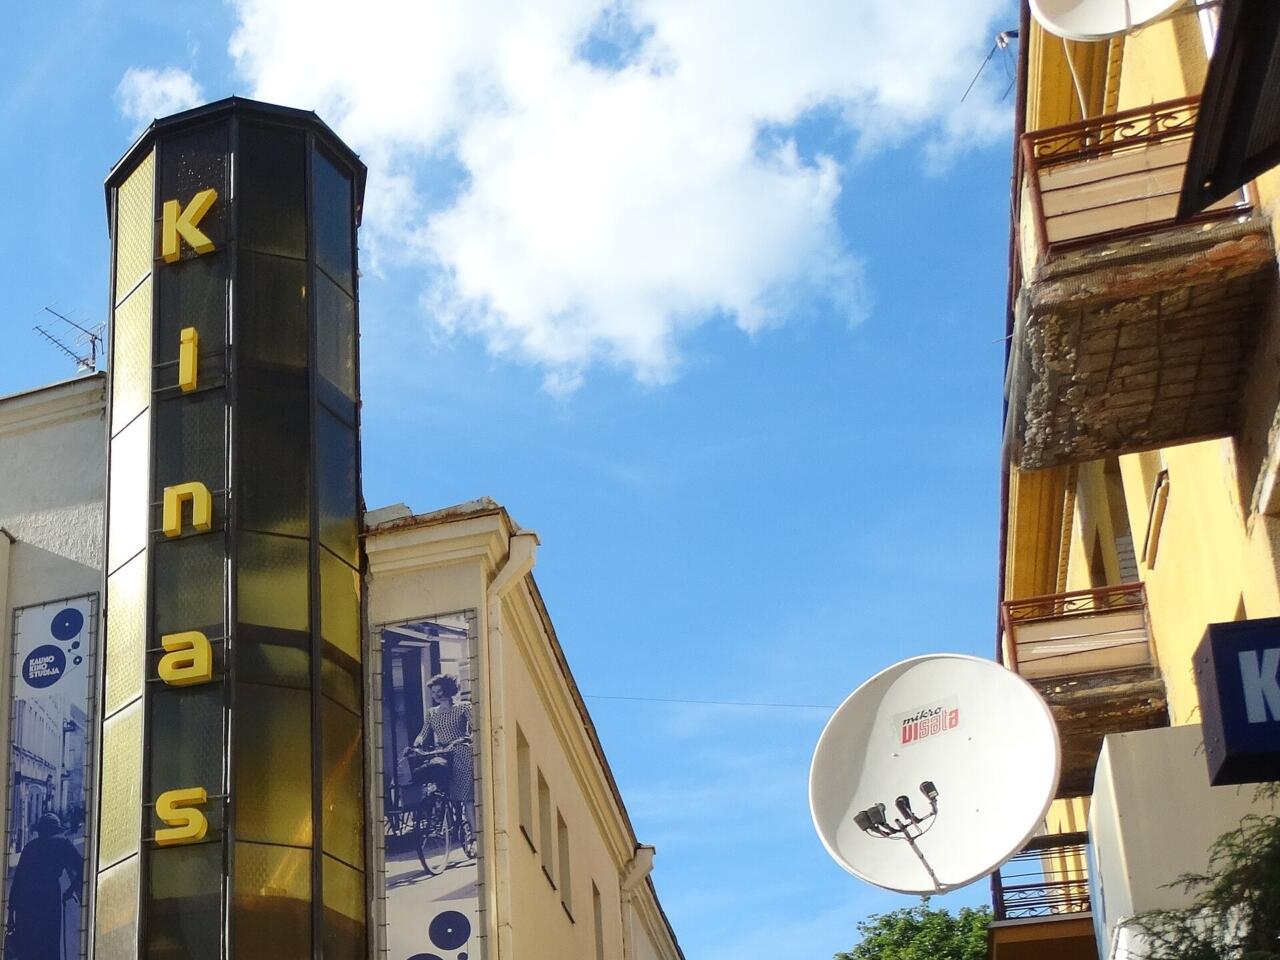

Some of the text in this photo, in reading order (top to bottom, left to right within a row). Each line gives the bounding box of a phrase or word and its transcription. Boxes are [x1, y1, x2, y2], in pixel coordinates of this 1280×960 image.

[156, 187, 220, 846] Kinas
[29, 655, 55, 666] KAUNO
[28, 667, 60, 679] STUDIJA
[29, 663, 48, 672] KINO
[902, 706, 942, 726] mikro
